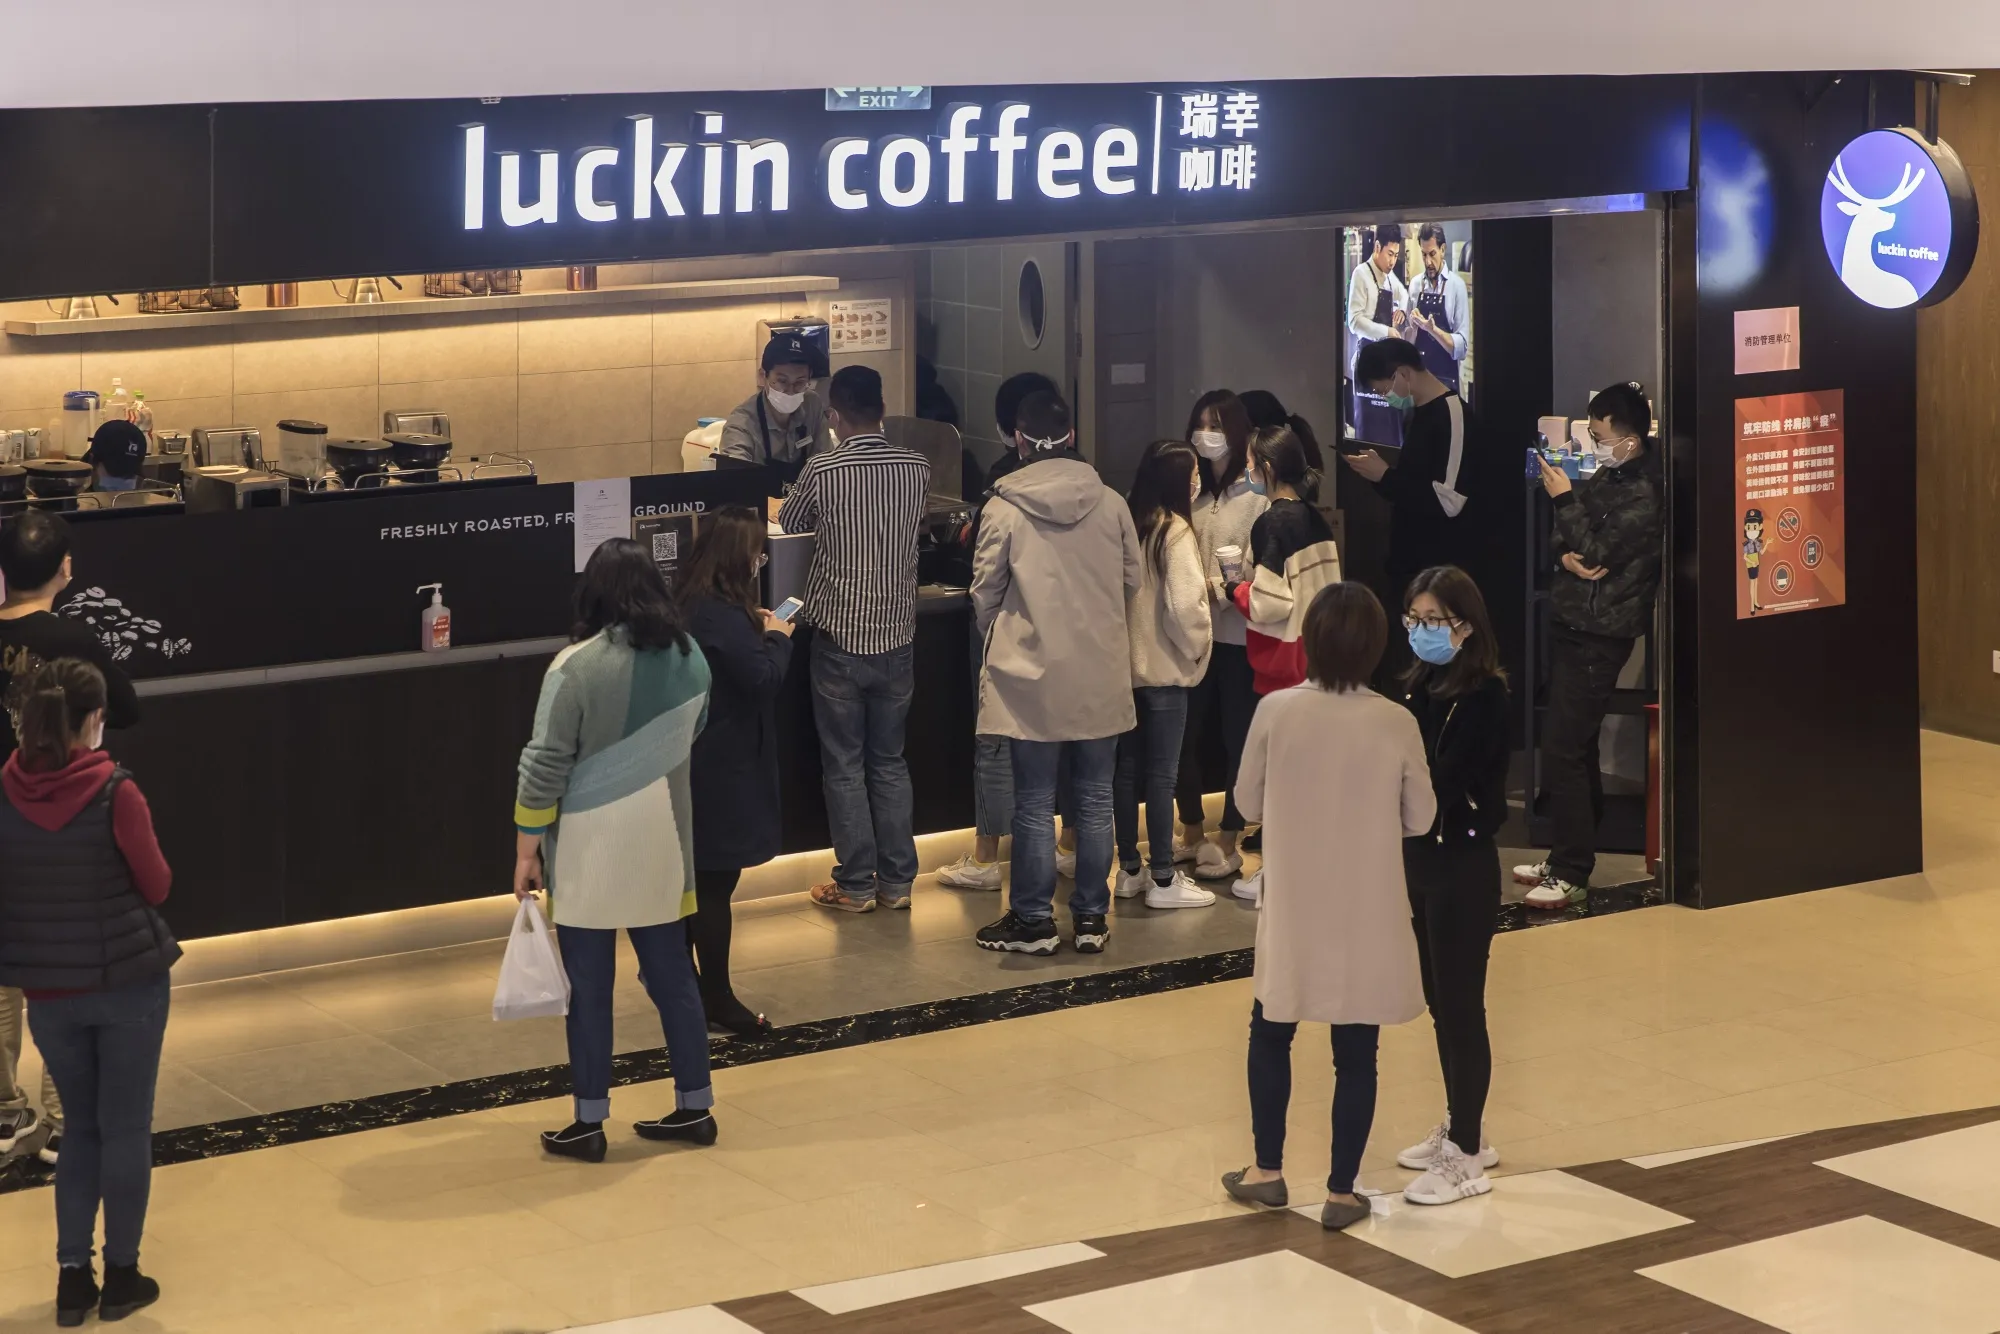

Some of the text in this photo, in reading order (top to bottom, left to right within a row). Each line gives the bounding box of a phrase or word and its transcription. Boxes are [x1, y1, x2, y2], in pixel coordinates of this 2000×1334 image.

[859, 95, 898, 107] EXIT
[1180, 92, 1260, 139] 瑞幸
[463, 103, 1139, 230] luckin coffee
[1178, 145, 1258, 192] 咖啡
[1877, 241, 1939, 261] luckin coffee
[1744, 333, 1792, 347] 消防管理单位
[380, 522, 459, 540] FRESHLY
[464, 514, 550, 533] ROASTED,
[634, 501, 706, 517] GROUND
